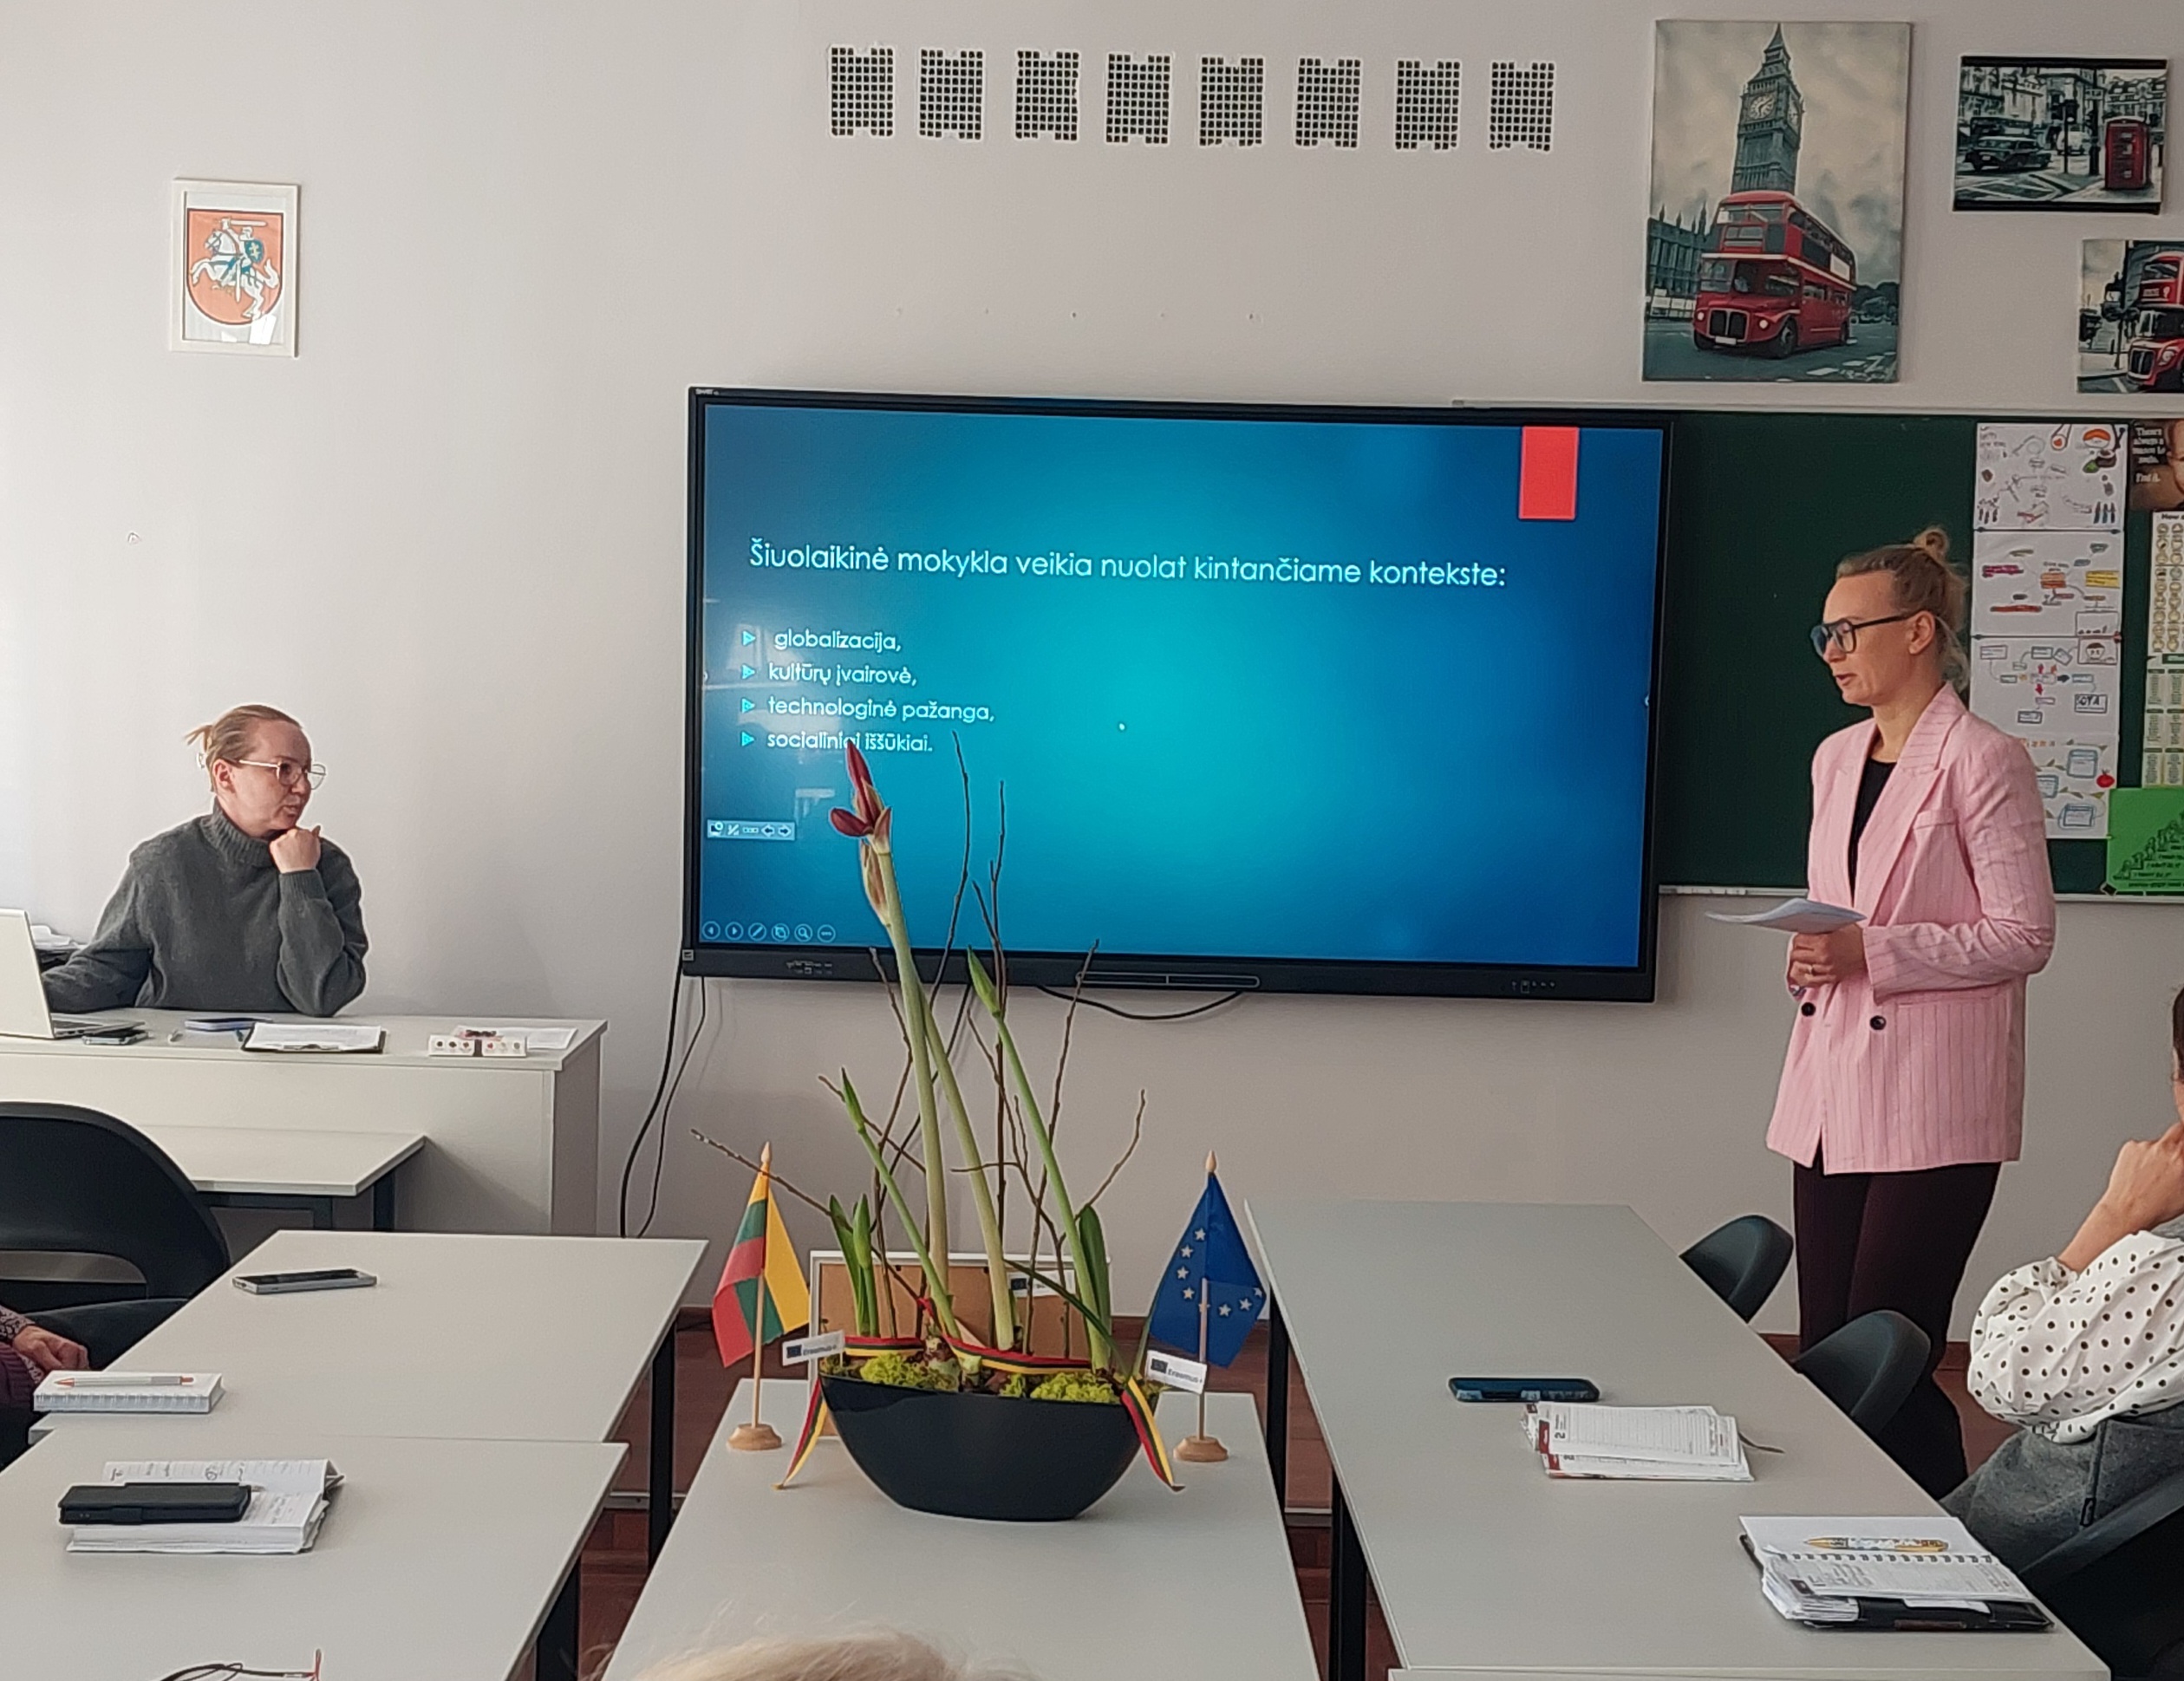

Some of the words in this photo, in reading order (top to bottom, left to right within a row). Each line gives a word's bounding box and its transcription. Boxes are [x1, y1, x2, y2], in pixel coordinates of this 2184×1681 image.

[749, 537, 890, 571] Šiuolaikinė
[897, 548, 1008, 578] mokykla
[1014, 551, 1092, 577] veikia
[1101, 554, 1188, 579] nuolat
[1194, 556, 1362, 583] kintančiame
[1369, 559, 1507, 587] kontekste:
[774, 628, 902, 654] globalizacija,
[768, 662, 831, 687] kultūrų
[836, 664, 917, 687] įvairovė,
[768, 695, 897, 720] technologinė
[902, 700, 994, 724] pažanga,
[864, 732, 933, 753] iššūkiai.
